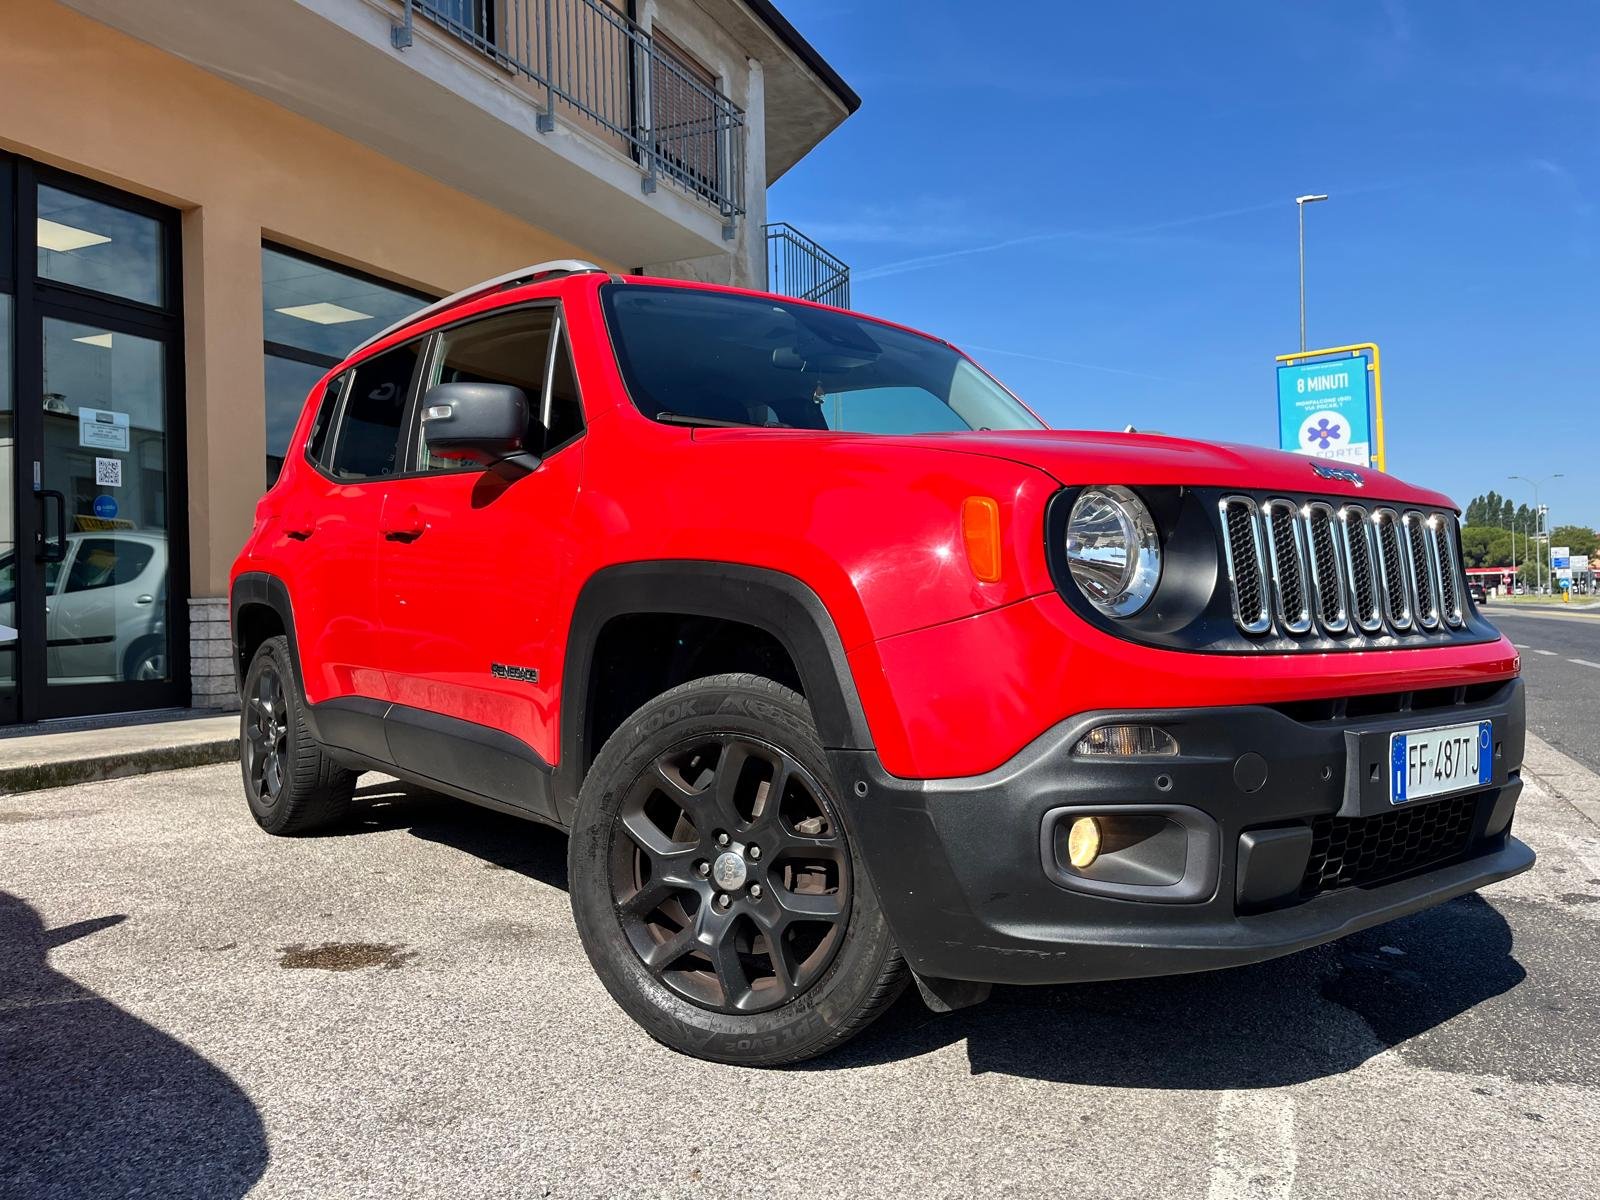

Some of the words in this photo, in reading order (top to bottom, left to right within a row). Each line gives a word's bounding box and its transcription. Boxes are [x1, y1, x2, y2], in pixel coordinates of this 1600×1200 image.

[1297, 378, 1305, 394] 8
[1308, 373, 1348, 392] MINUTI
[1408, 743, 1429, 787] FF
[1434, 735, 1479, 781] 487TJ
